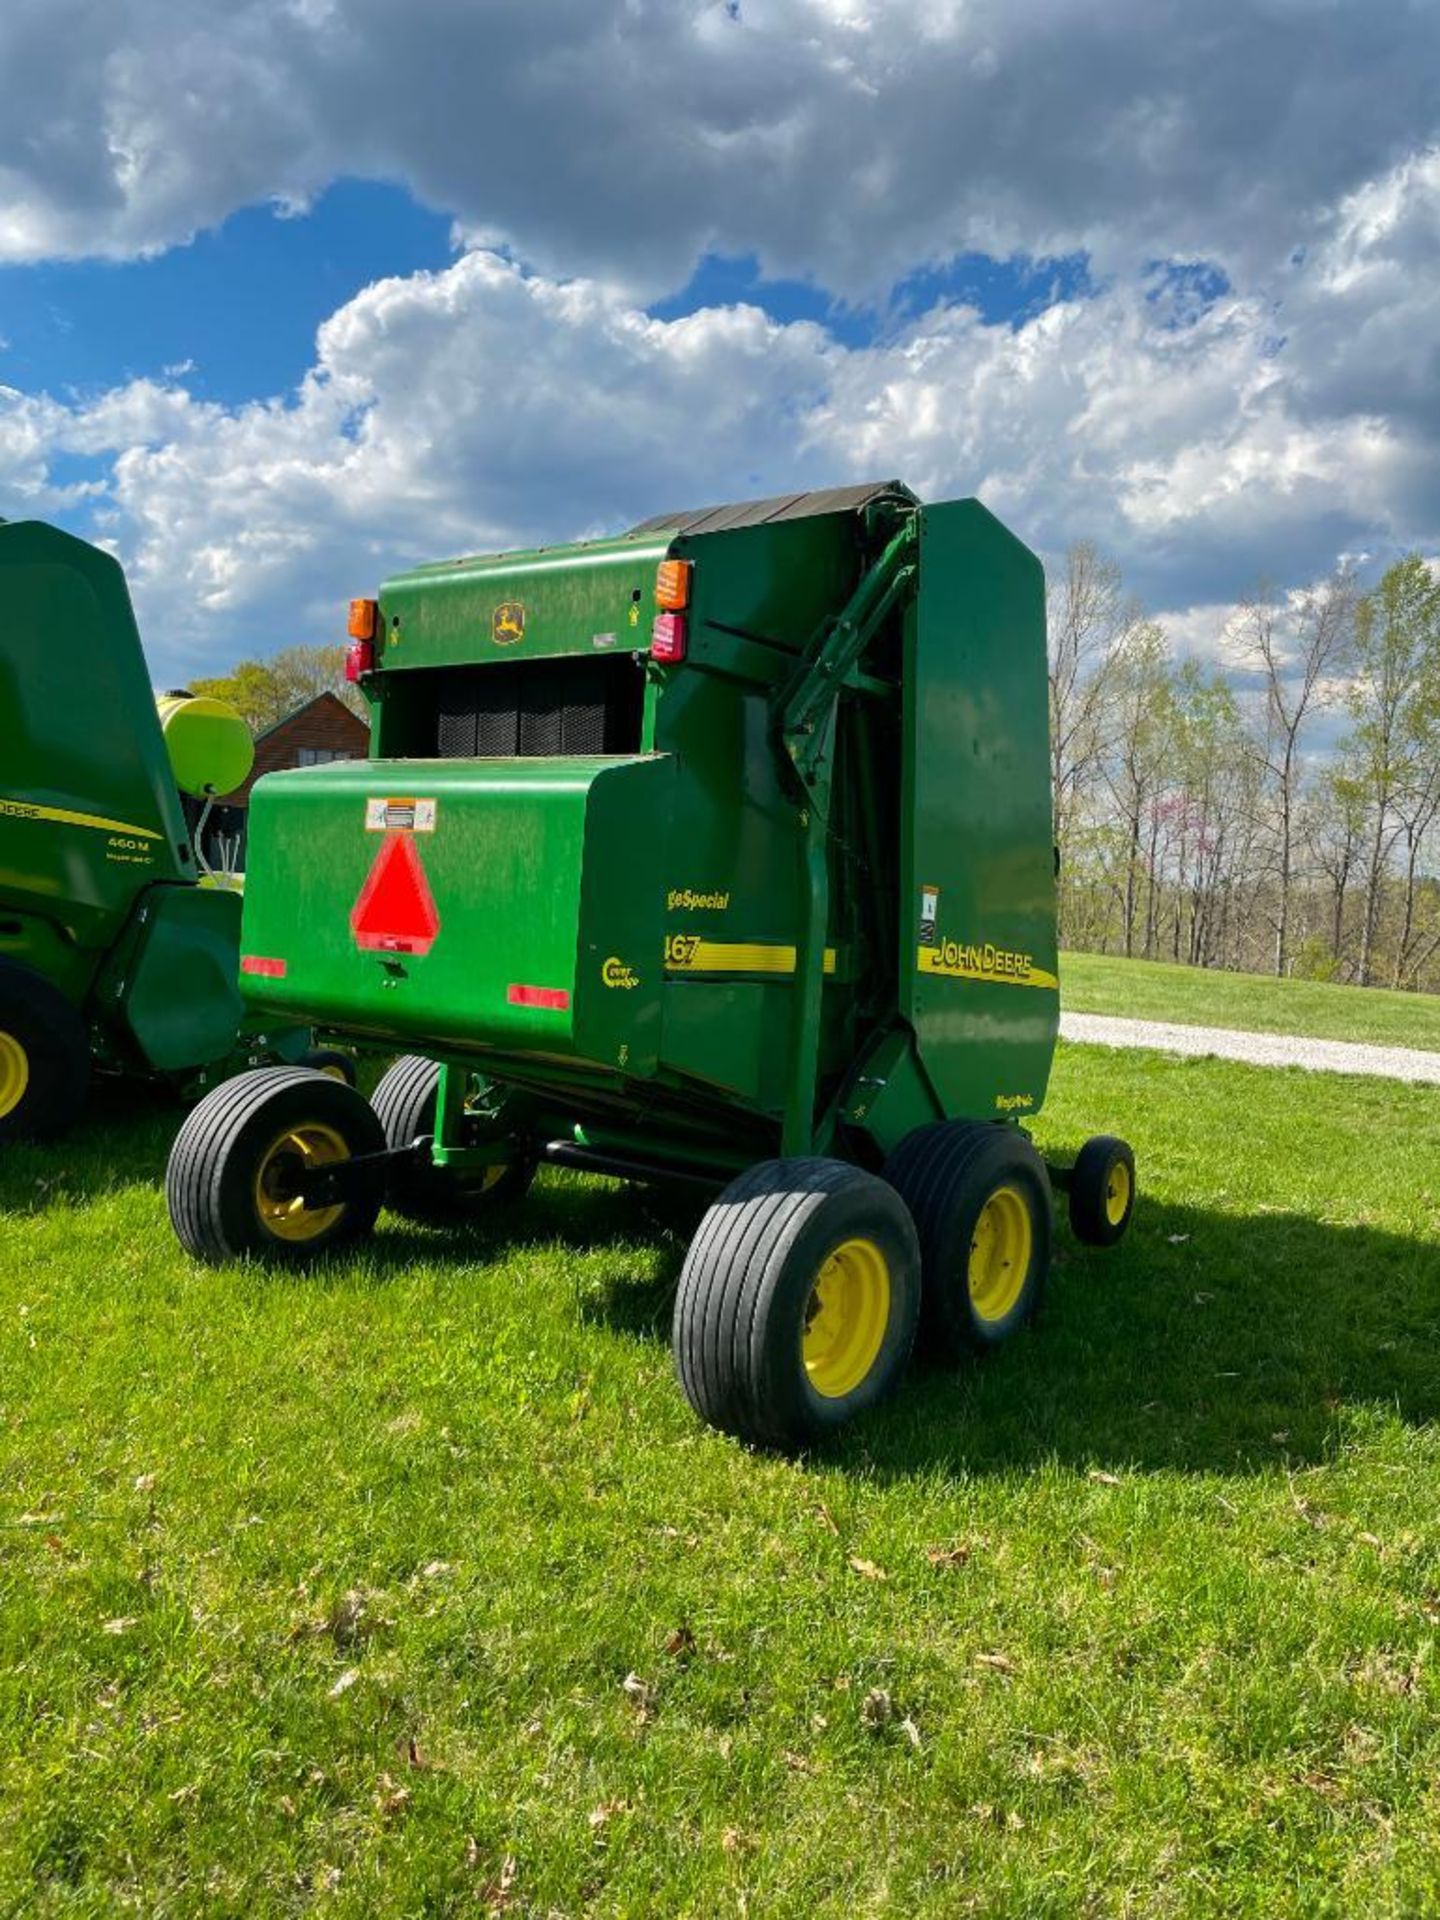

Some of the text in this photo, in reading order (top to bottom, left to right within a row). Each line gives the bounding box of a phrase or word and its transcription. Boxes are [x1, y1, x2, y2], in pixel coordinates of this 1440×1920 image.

[108, 837, 149, 851] 460 M
[932, 936, 1033, 977] JOHN DEERE
